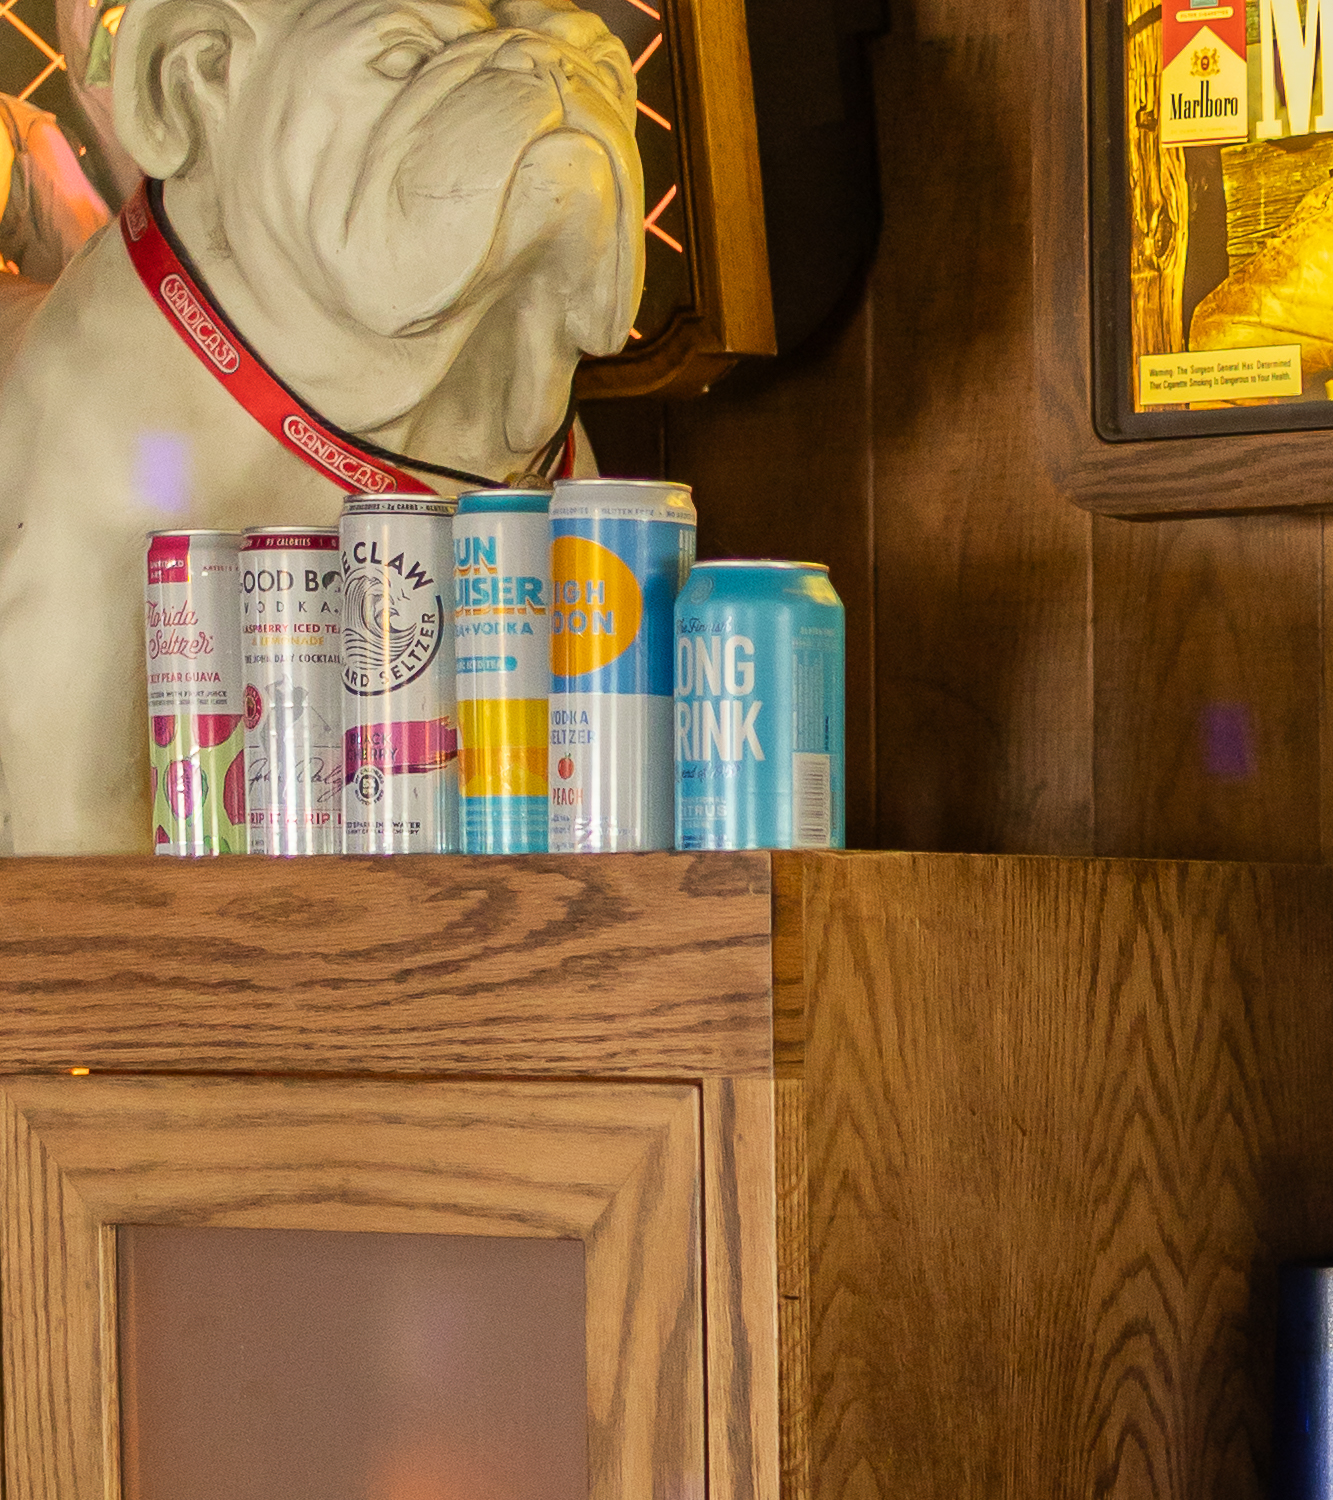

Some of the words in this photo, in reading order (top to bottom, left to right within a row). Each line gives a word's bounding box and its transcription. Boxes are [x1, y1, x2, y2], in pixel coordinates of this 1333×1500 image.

[1170, 80, 1239, 121] Marlboro
[166, 280, 236, 368] SANDICAST
[1189, 377, 1212, 388] Smoking
[1220, 375, 1249, 386] Dangerous
[1217, 362, 1240, 373] General
[1241, 362, 1254, 370] Has
[1256, 359, 1291, 370] Determined
[290, 421, 393, 495] SANDICAST
[353, 541, 434, 591] CLAW
[455, 536, 496, 566] UN
[552, 579, 605, 605] IGH
[294, 624, 320, 633] ICED
[379, 612, 436, 686] SELTZER
[185, 672, 221, 683] GUAVA
[676, 634, 755, 697] ONG
[677, 700, 766, 762] RINK
